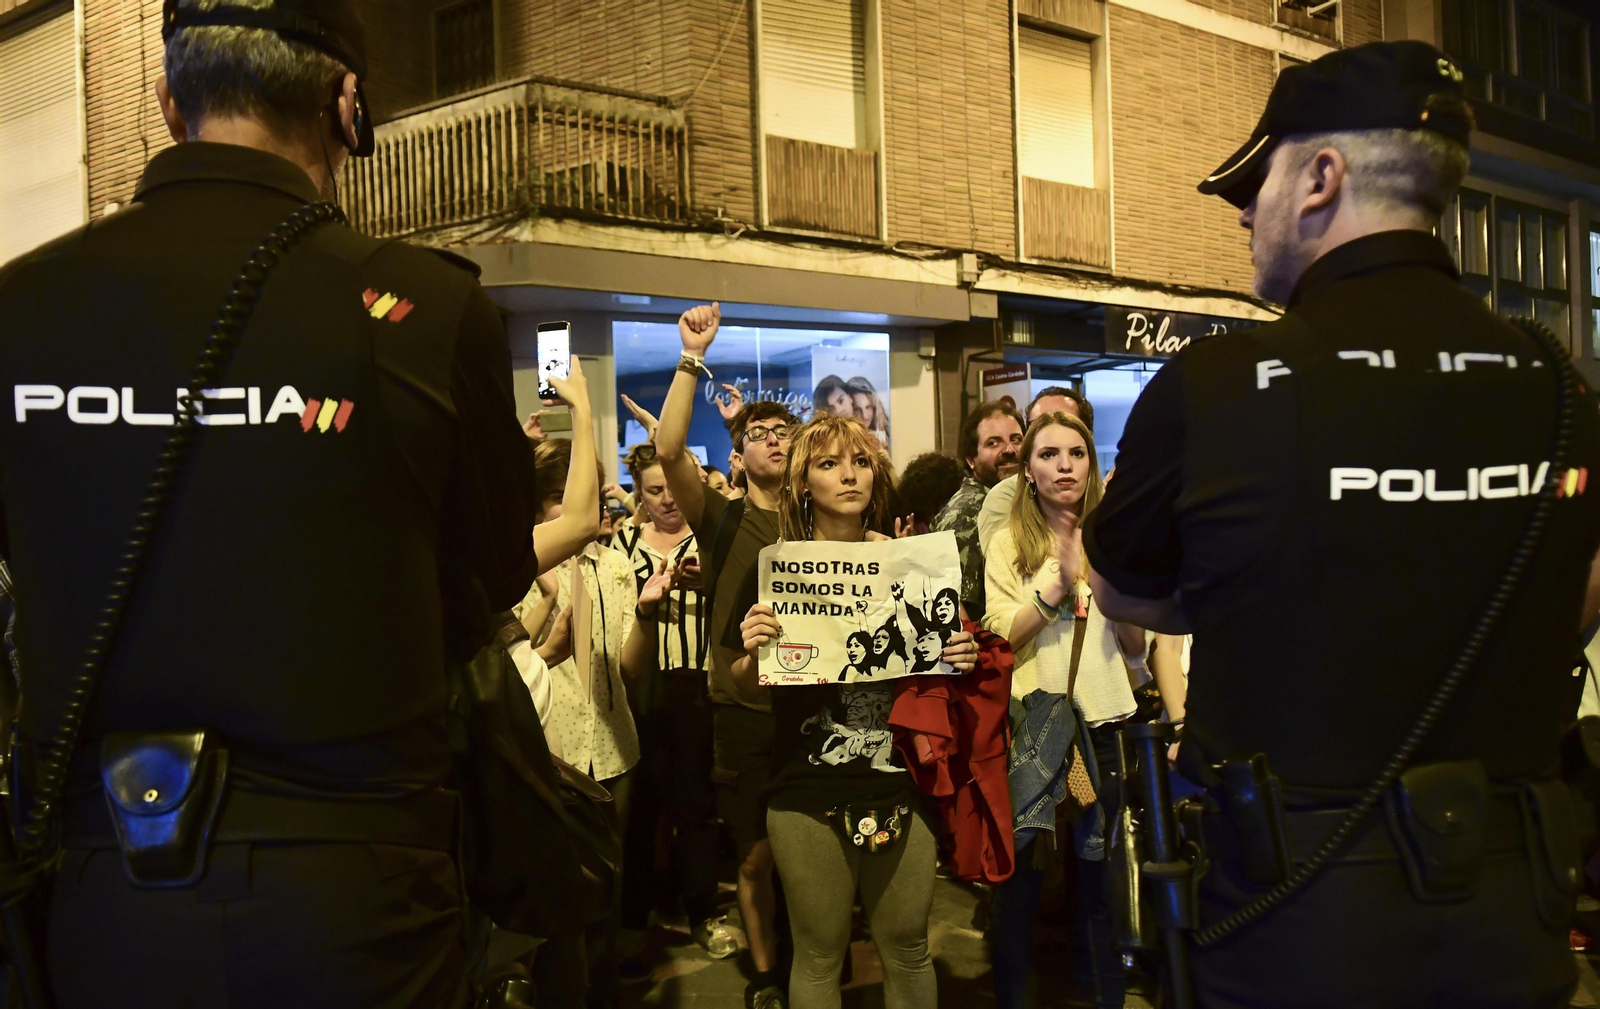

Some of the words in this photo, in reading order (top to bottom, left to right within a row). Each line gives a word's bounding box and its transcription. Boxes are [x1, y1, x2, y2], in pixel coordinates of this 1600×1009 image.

[14, 384, 306, 426] POLICIA
[771, 561, 880, 575] NOSOTRAS
[771, 581, 845, 596] SOMOS
[851, 584, 873, 597] LA
[771, 601, 854, 617] MANADA
